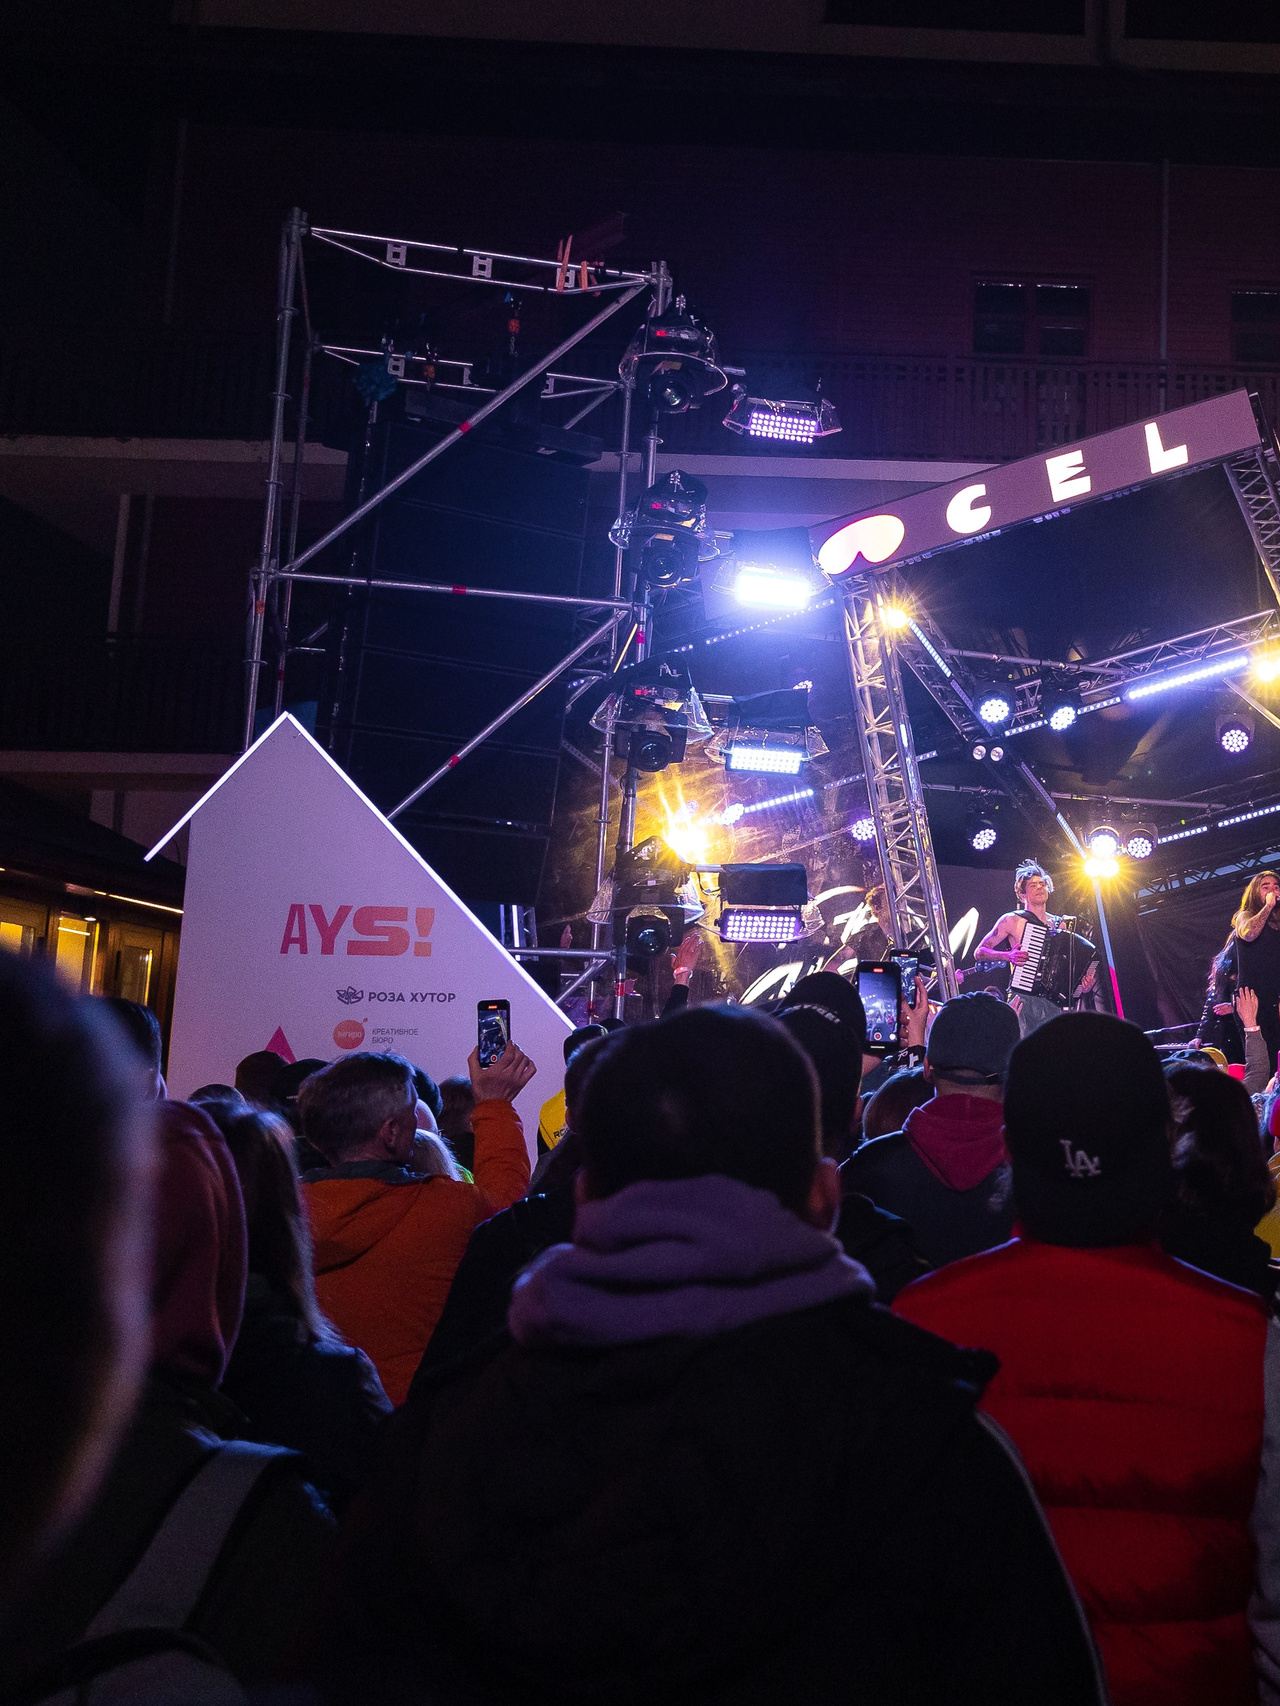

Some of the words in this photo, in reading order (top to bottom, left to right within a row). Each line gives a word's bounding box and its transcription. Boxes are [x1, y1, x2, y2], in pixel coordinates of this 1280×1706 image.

[280, 904, 435, 957] AYS!
[368, 992, 405, 1002] РОЗА
[410, 992, 456, 1003] ХУТОР
[372, 1028, 419, 1036] КРЕАТИВНОЕ
[1060, 1139, 1101, 1177] LA
